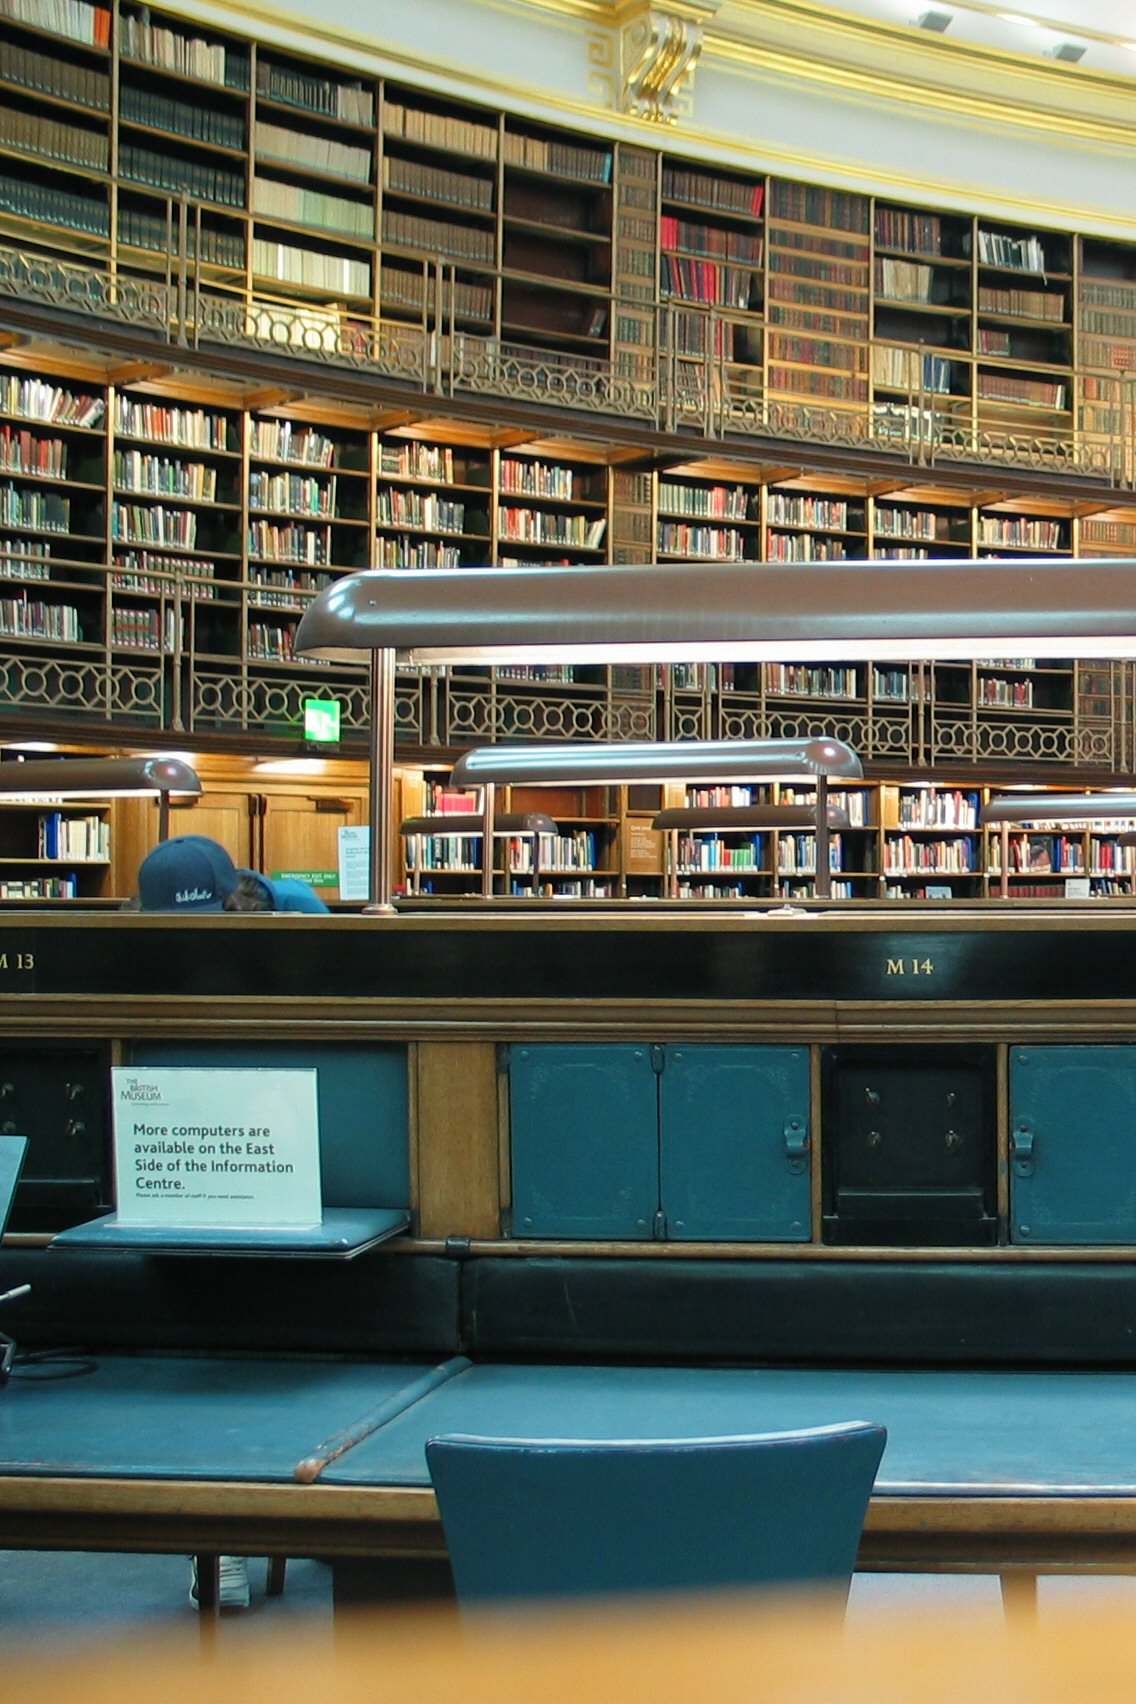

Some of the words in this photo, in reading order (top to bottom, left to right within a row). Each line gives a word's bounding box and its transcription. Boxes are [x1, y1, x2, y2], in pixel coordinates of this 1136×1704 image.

[17, 953, 35, 970] 13
[886, 958, 905, 975] M
[912, 958, 934, 975] 14
[133, 1123, 168, 1137] More
[171, 1124, 245, 1140] computers
[248, 1126, 271, 1138] are
[134, 1141, 195, 1155] available
[198, 1143, 216, 1155] on
[219, 1142, 242, 1155] the
[246, 1142, 275, 1156] East
[135, 1159, 163, 1172] Side
[166, 1158, 182, 1172] of
[185, 1160, 208, 1173] the
[211, 1160, 294, 1174] Information
[135, 1176, 186, 1190] Centre.
